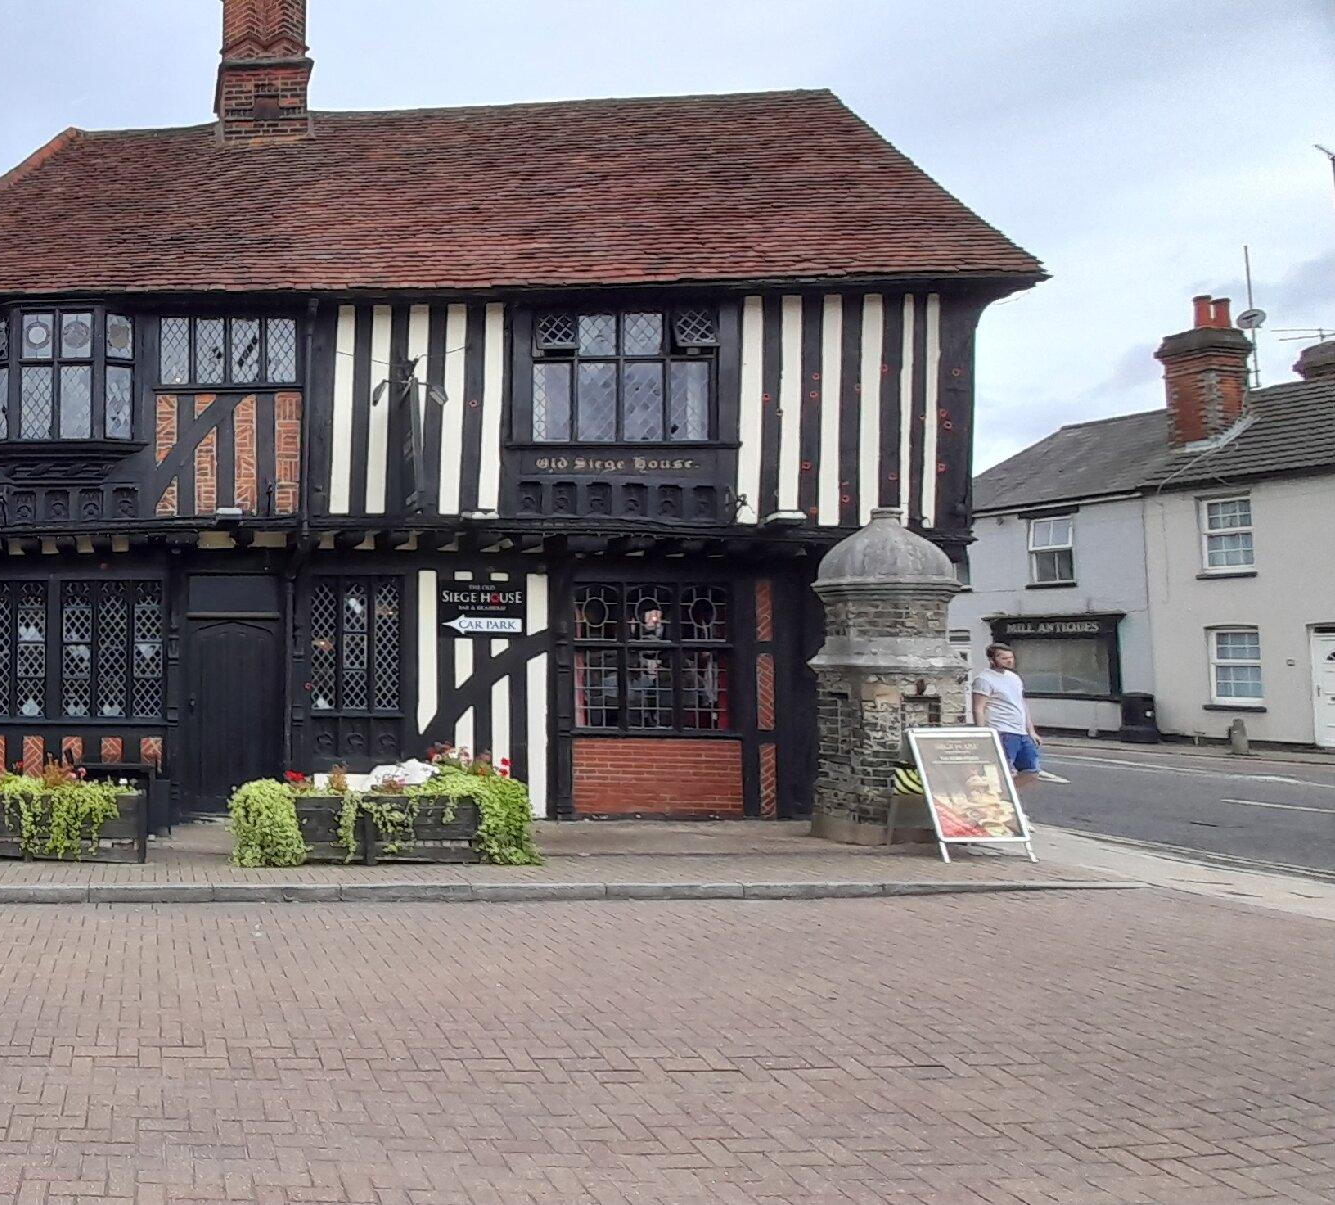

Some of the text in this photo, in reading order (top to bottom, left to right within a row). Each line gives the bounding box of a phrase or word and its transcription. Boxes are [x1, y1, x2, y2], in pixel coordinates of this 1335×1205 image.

[535, 457, 568, 473] Old
[573, 457, 626, 473] Siege
[442, 590, 523, 604] SIEGE HOUSE
[458, 620, 516, 630] CAR PARK
[1006, 621, 1100, 634] MILL ANTIQUES
